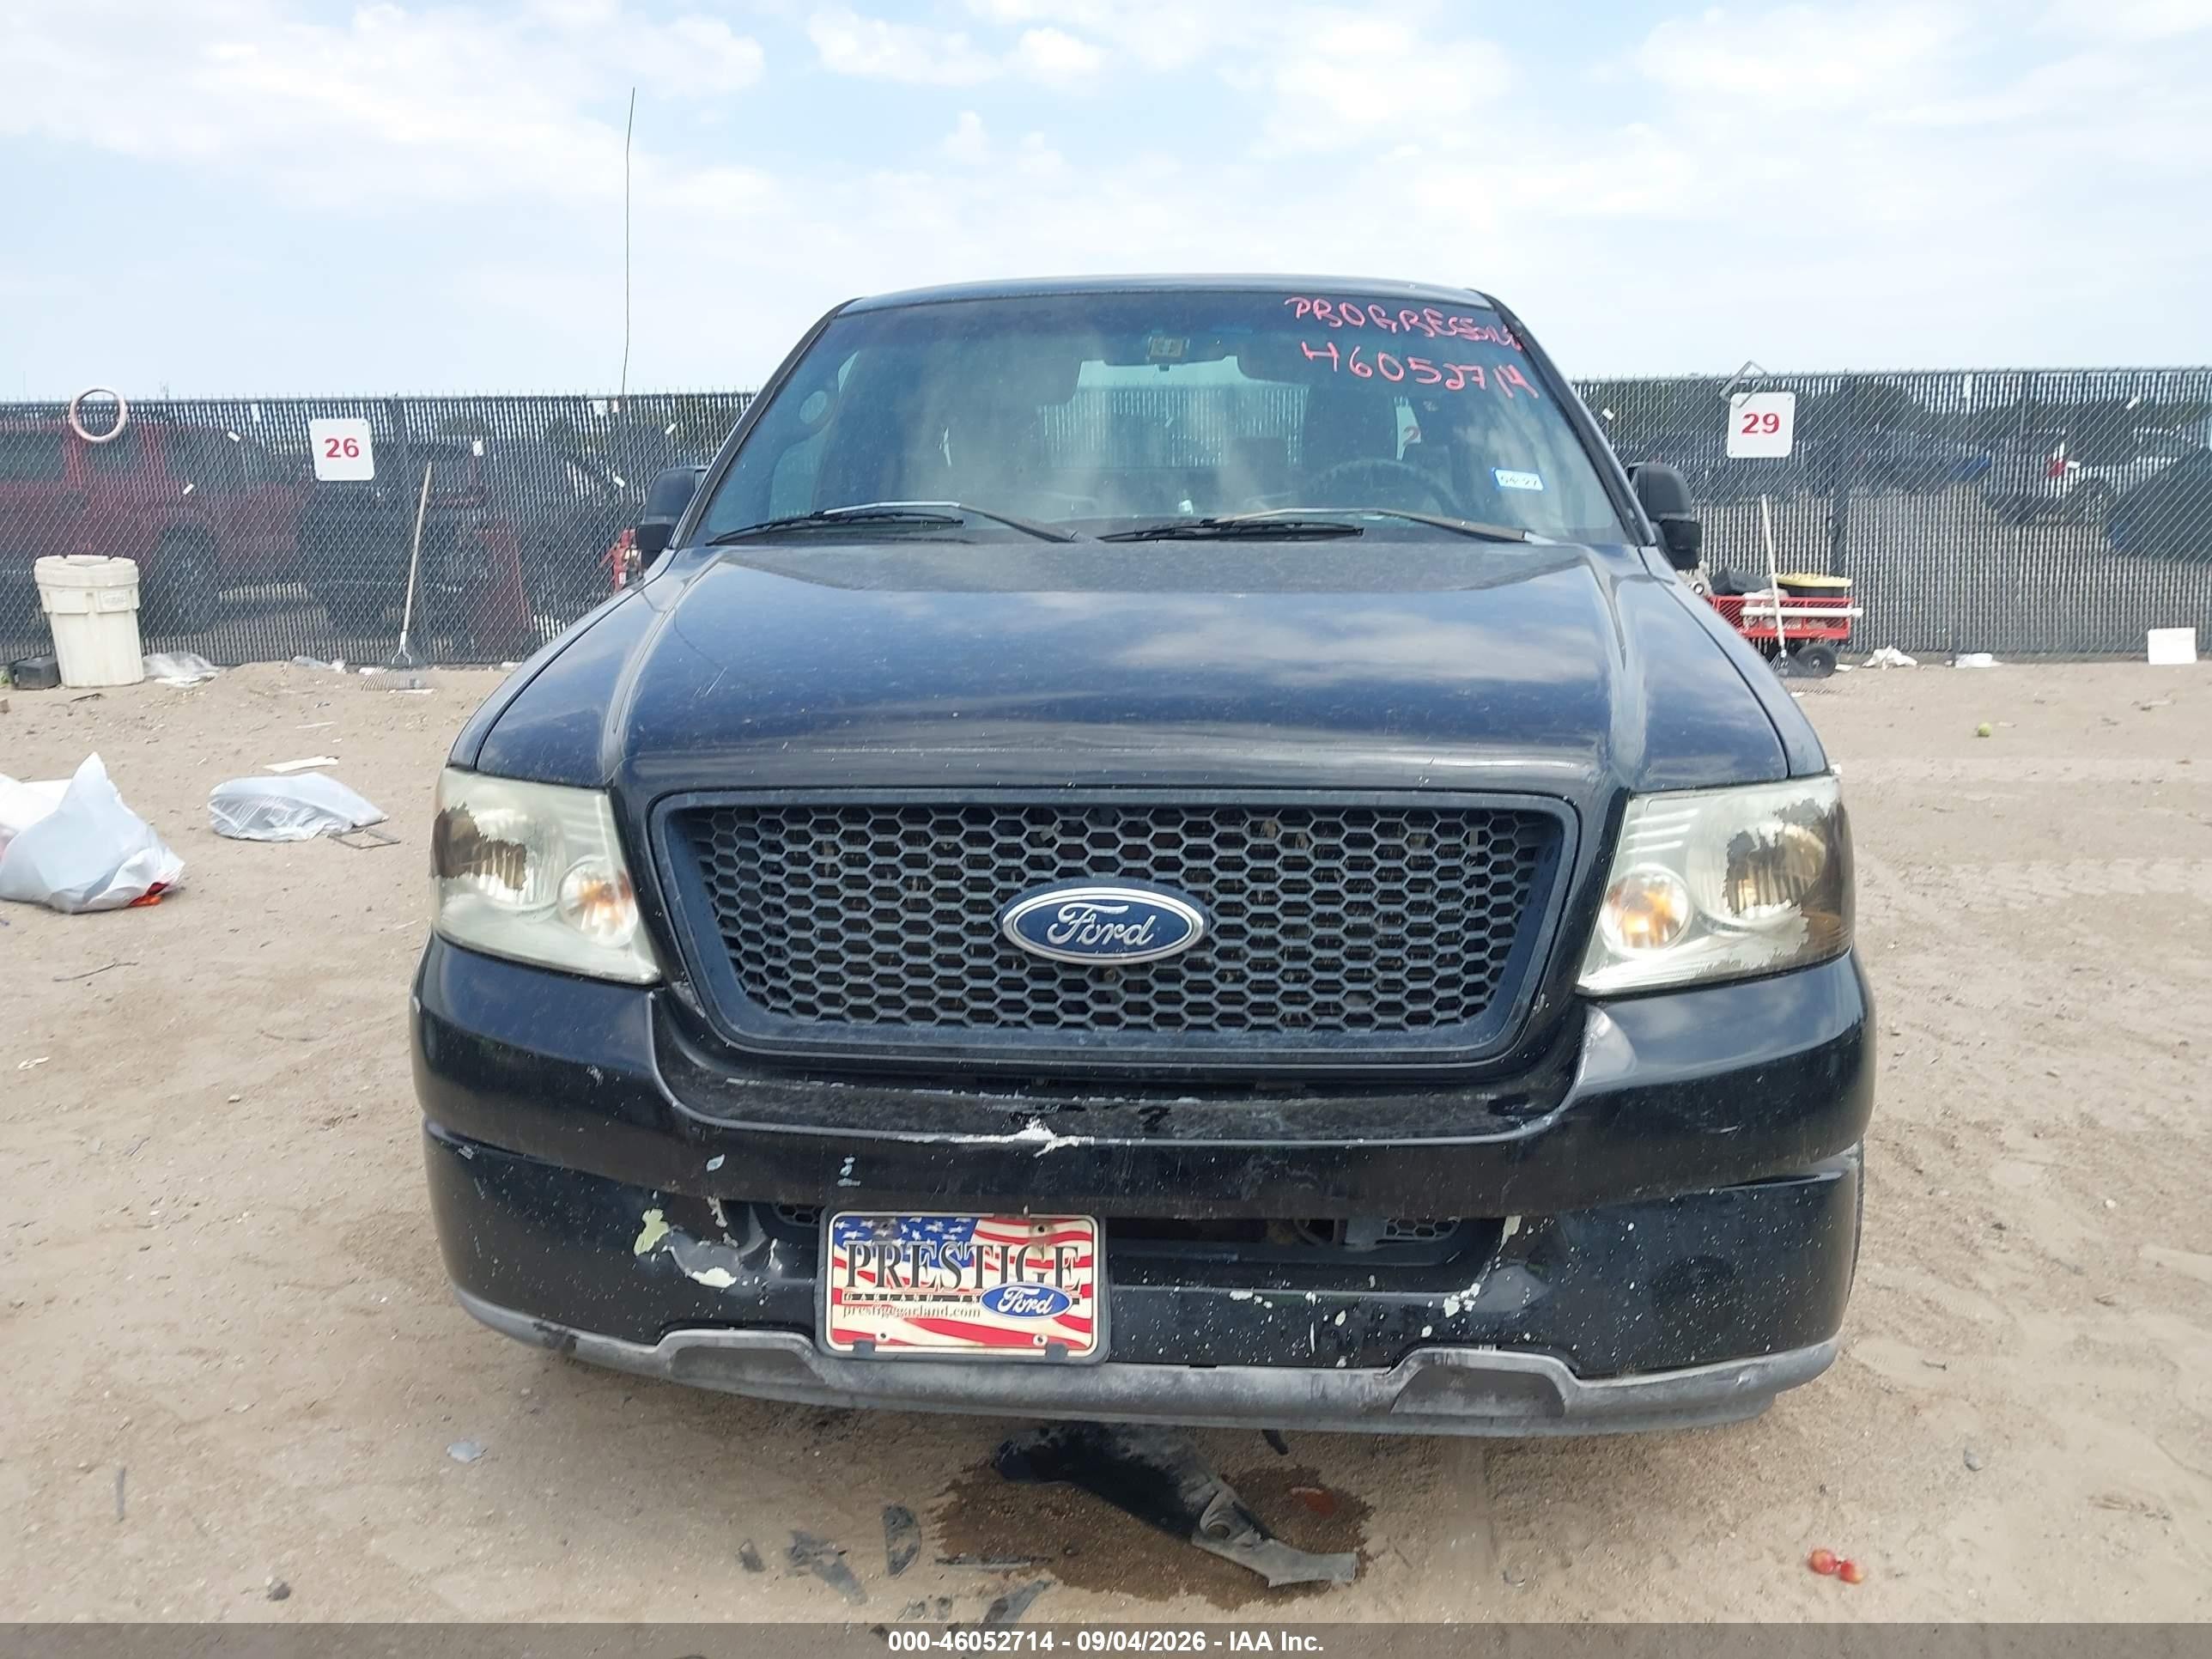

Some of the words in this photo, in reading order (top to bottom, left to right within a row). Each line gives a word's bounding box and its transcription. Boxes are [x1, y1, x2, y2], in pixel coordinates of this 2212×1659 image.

[1741, 413, 1779, 434] 29
[325, 438, 359, 458] 26
[1047, 902, 1157, 945] Ford
[845, 1242, 1082, 1291] PRESTIGE
[997, 1286, 1053, 1315] Ford
